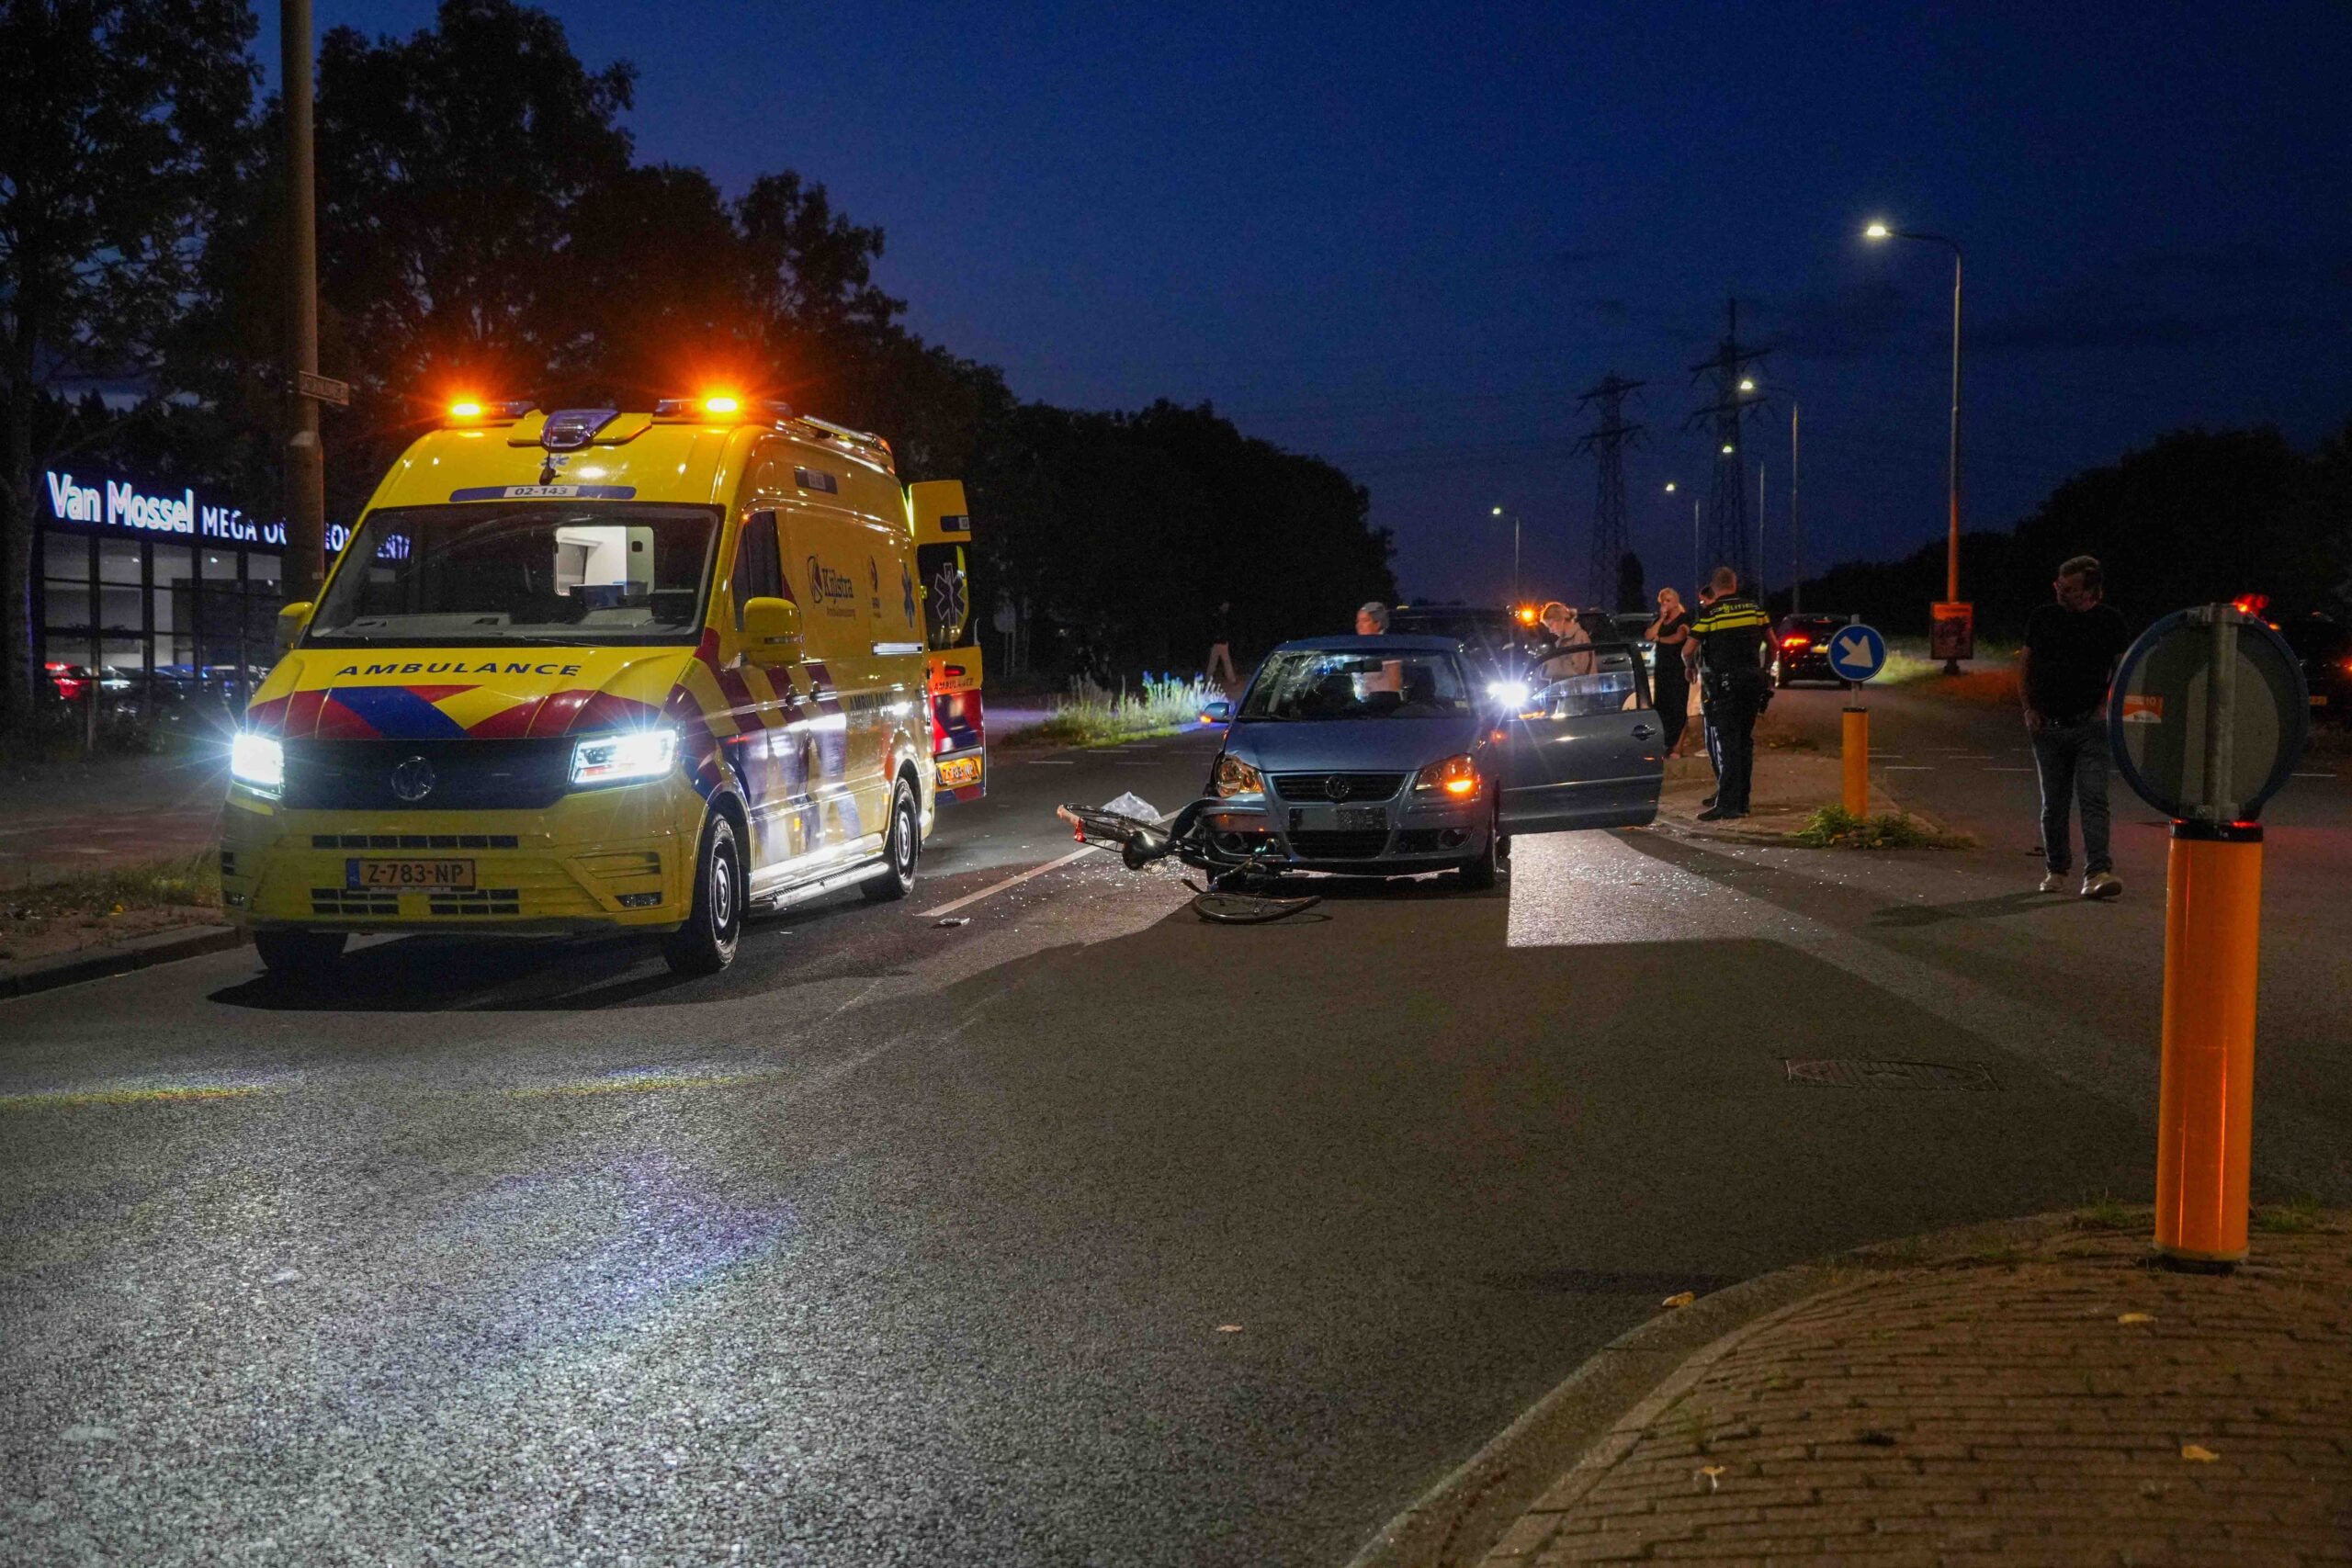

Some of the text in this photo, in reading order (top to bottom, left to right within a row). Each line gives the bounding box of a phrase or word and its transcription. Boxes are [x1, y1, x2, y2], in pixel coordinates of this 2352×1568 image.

[514, 486, 569, 497] 02-143
[47, 471, 101, 523] Van
[107, 479, 194, 534] Mossel
[202, 506, 258, 541] MEGA
[335, 661, 582, 677] AMBULANCE
[368, 863, 464, 884] Z-783-NP
